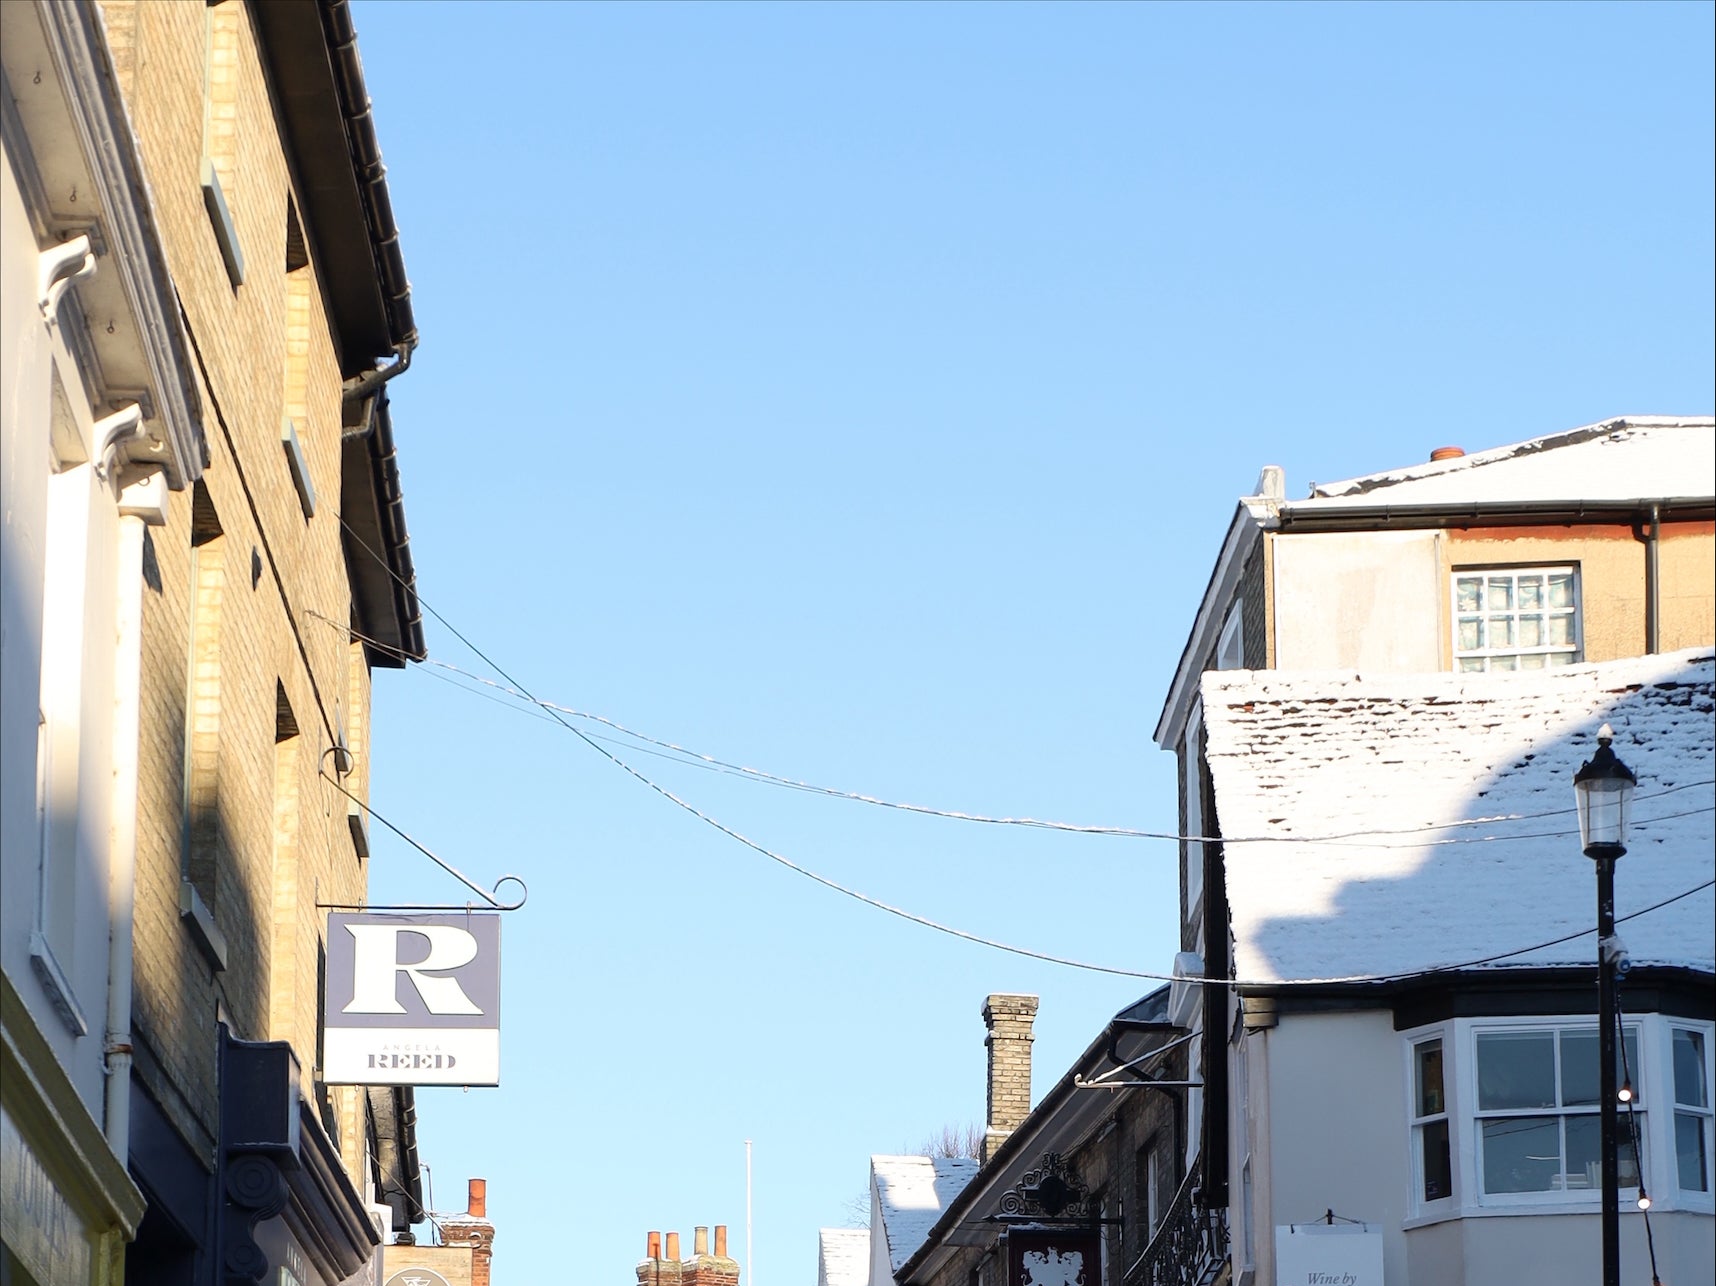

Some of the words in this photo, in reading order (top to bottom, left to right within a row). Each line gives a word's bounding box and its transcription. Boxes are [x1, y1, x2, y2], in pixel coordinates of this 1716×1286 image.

[341, 924, 486, 1016] R
[368, 1054, 456, 1069] REED
[1307, 1272, 1341, 1285] Wine
[1342, 1272, 1357, 1286] by
